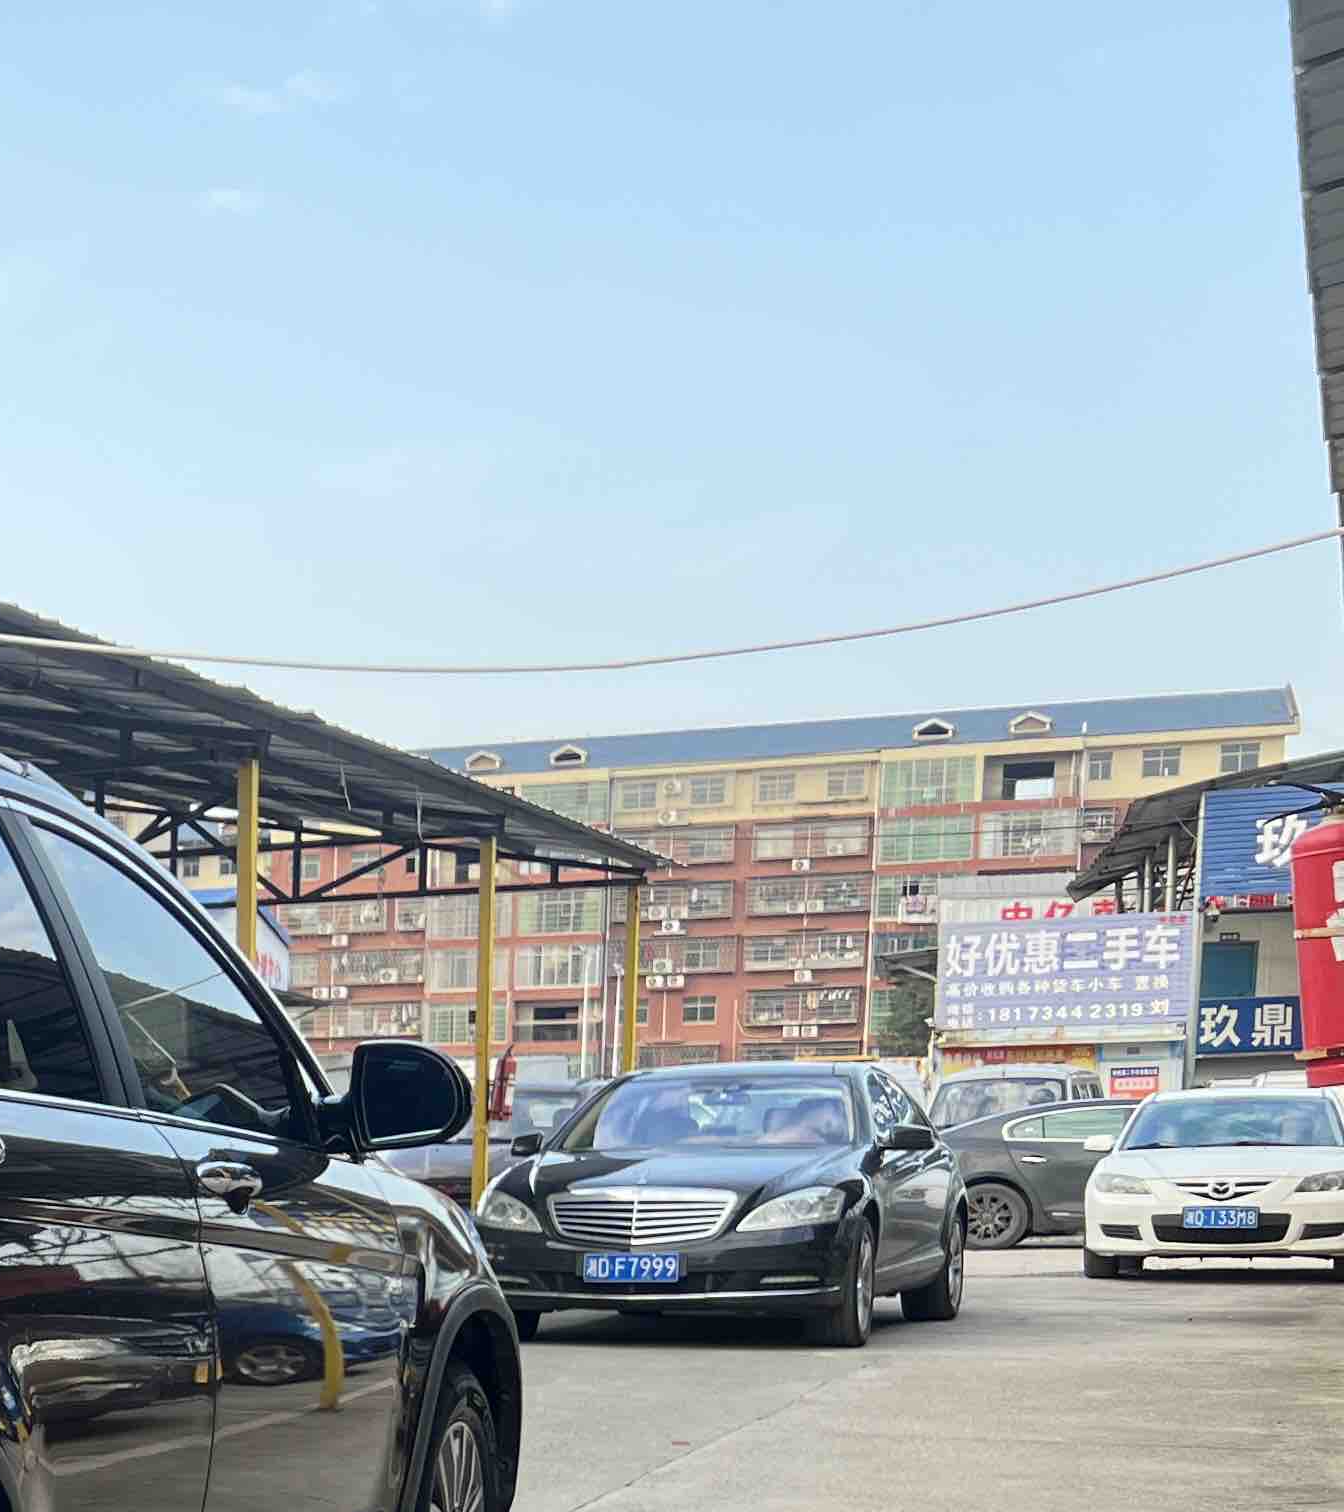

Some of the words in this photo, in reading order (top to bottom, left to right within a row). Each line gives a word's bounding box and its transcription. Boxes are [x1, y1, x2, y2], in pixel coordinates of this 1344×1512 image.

[945, 924, 1181, 977] 好优惠二手车
[1199, 1003, 1293, 1047] 玖鼎
